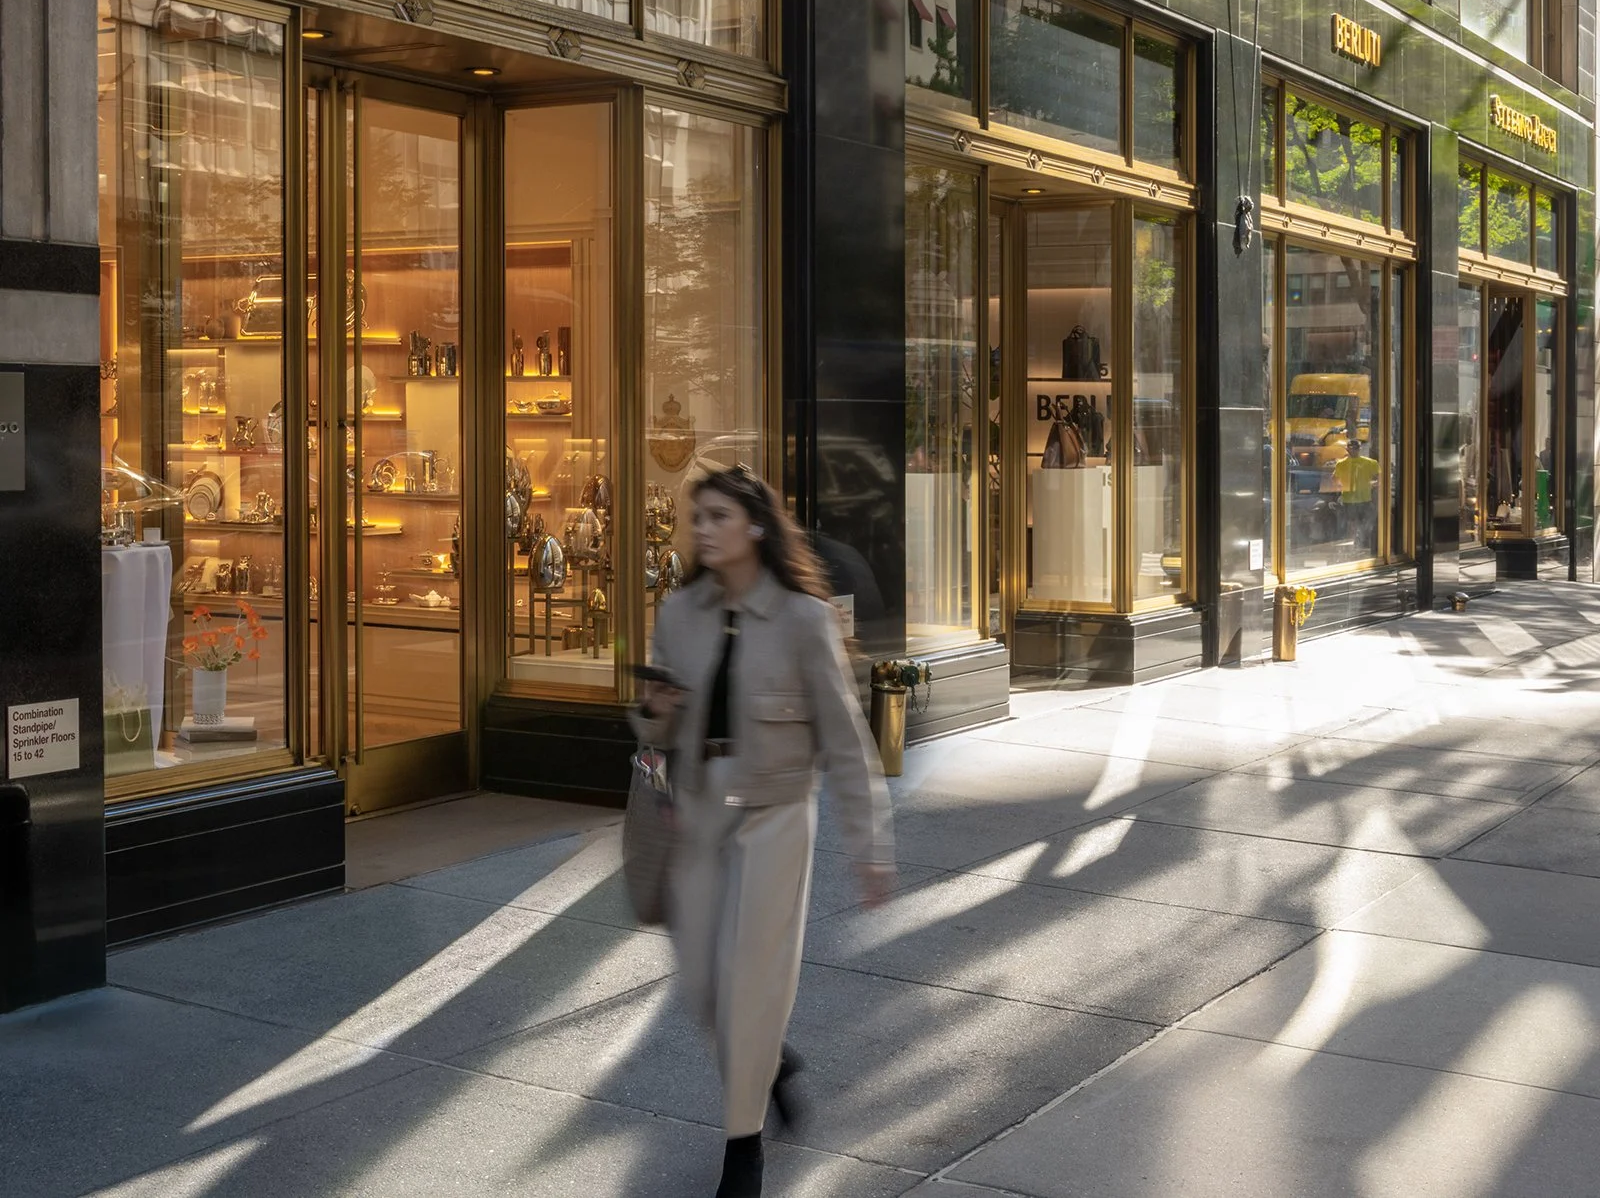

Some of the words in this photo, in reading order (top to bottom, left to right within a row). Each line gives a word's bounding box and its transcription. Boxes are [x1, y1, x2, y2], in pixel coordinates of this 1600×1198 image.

[1332, 13, 1381, 67] BERLUTI
[13, 707, 64, 722] Combination
[13, 720, 57, 735] Standpipe/
[13, 735, 50, 750] Sprinkler
[51, 732, 76, 743] Floors
[13, 752, 22, 762] 15
[24, 751, 33, 760] to
[34, 748, 44, 759] 42
